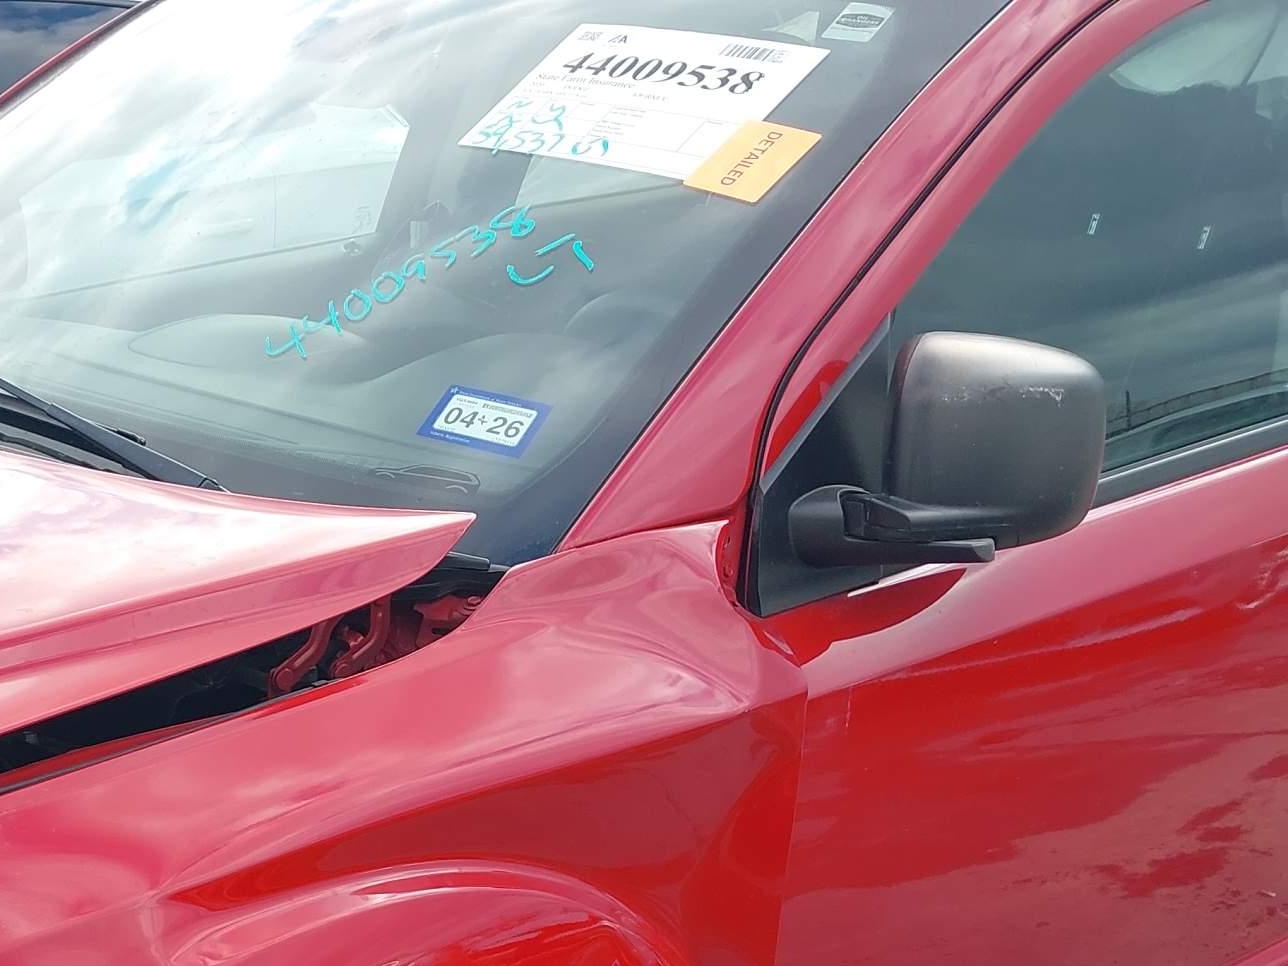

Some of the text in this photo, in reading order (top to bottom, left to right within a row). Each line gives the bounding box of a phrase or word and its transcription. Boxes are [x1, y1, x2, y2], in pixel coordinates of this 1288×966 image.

[562, 51, 766, 95] 44009538
[720, 130, 784, 187] DETAILED
[264, 204, 537, 360] 44009538
[443, 407, 479, 429] 04
[485, 416, 525, 439] 26
